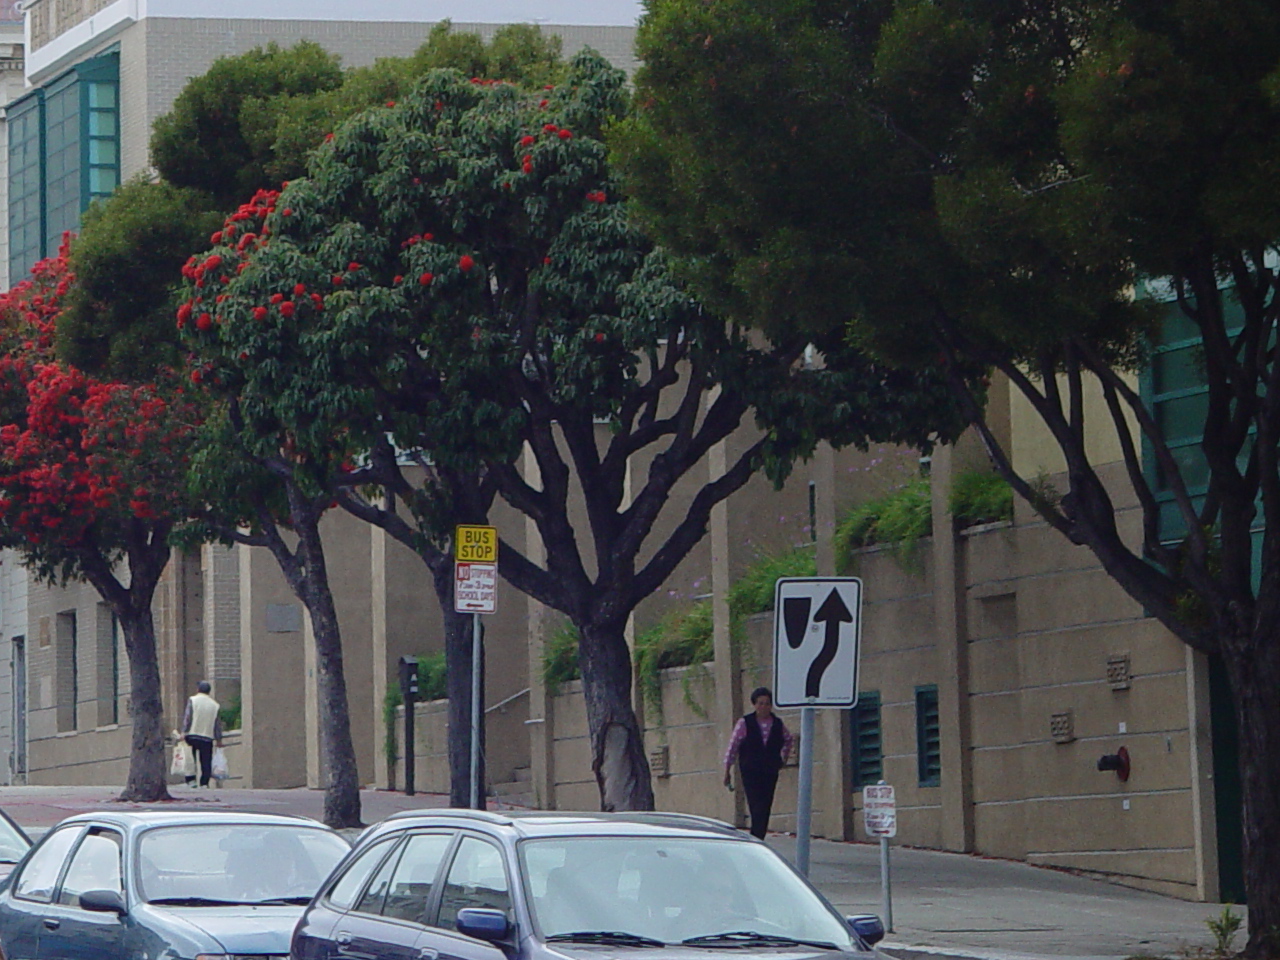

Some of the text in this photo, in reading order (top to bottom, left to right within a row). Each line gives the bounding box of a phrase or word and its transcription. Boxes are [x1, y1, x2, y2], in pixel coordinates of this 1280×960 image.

[465, 530, 489, 544] BUS
[461, 545, 493, 558] STOP
[867, 788, 892, 798] BUS STOP
